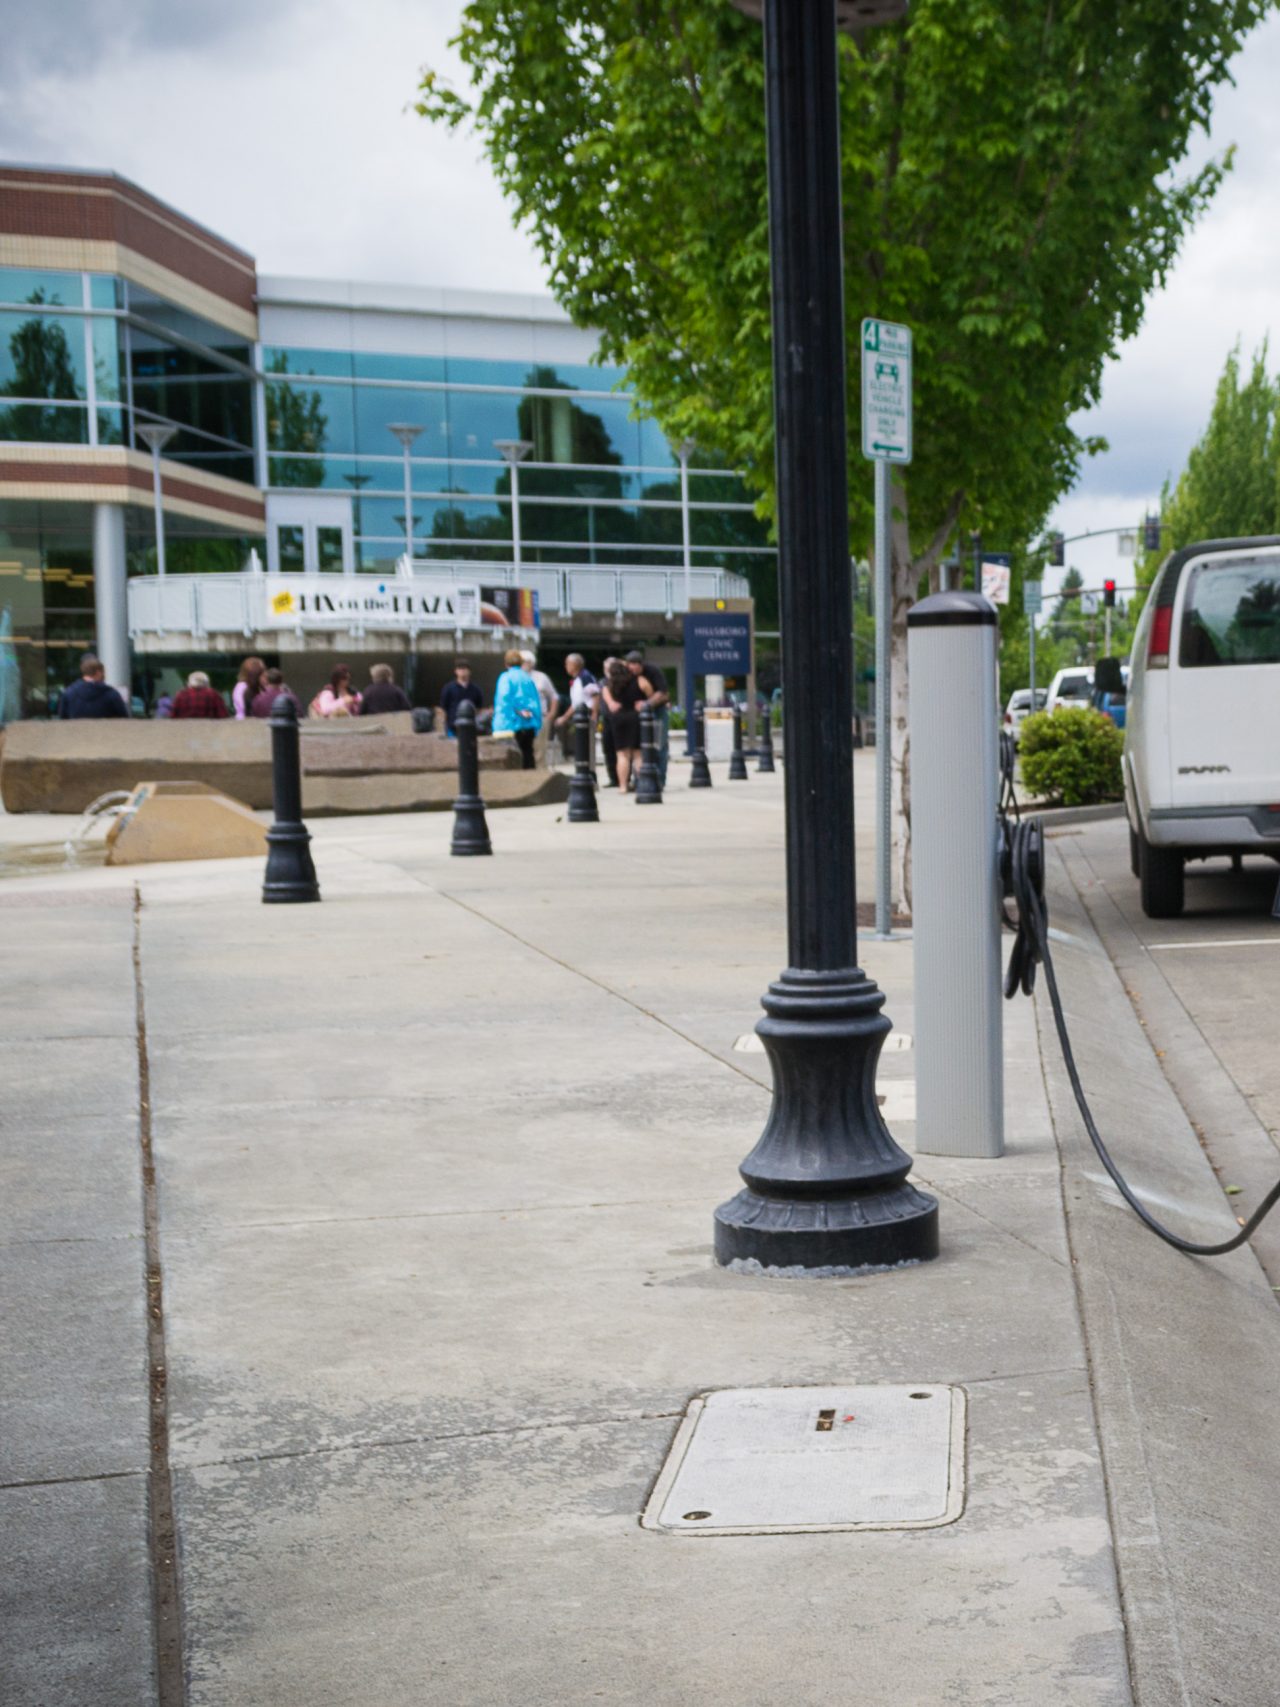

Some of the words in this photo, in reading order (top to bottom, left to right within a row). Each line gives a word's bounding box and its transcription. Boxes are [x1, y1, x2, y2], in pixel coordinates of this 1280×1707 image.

[864, 321, 877, 348] 4
[872, 393, 902, 406] VEHICLE
[338, 600, 358, 611] on
[363, 597, 390, 611] the
[694, 627, 747, 637] HILLSBORO
[707, 638, 733, 649] CIVIC
[702, 650, 740, 660] CENTER
